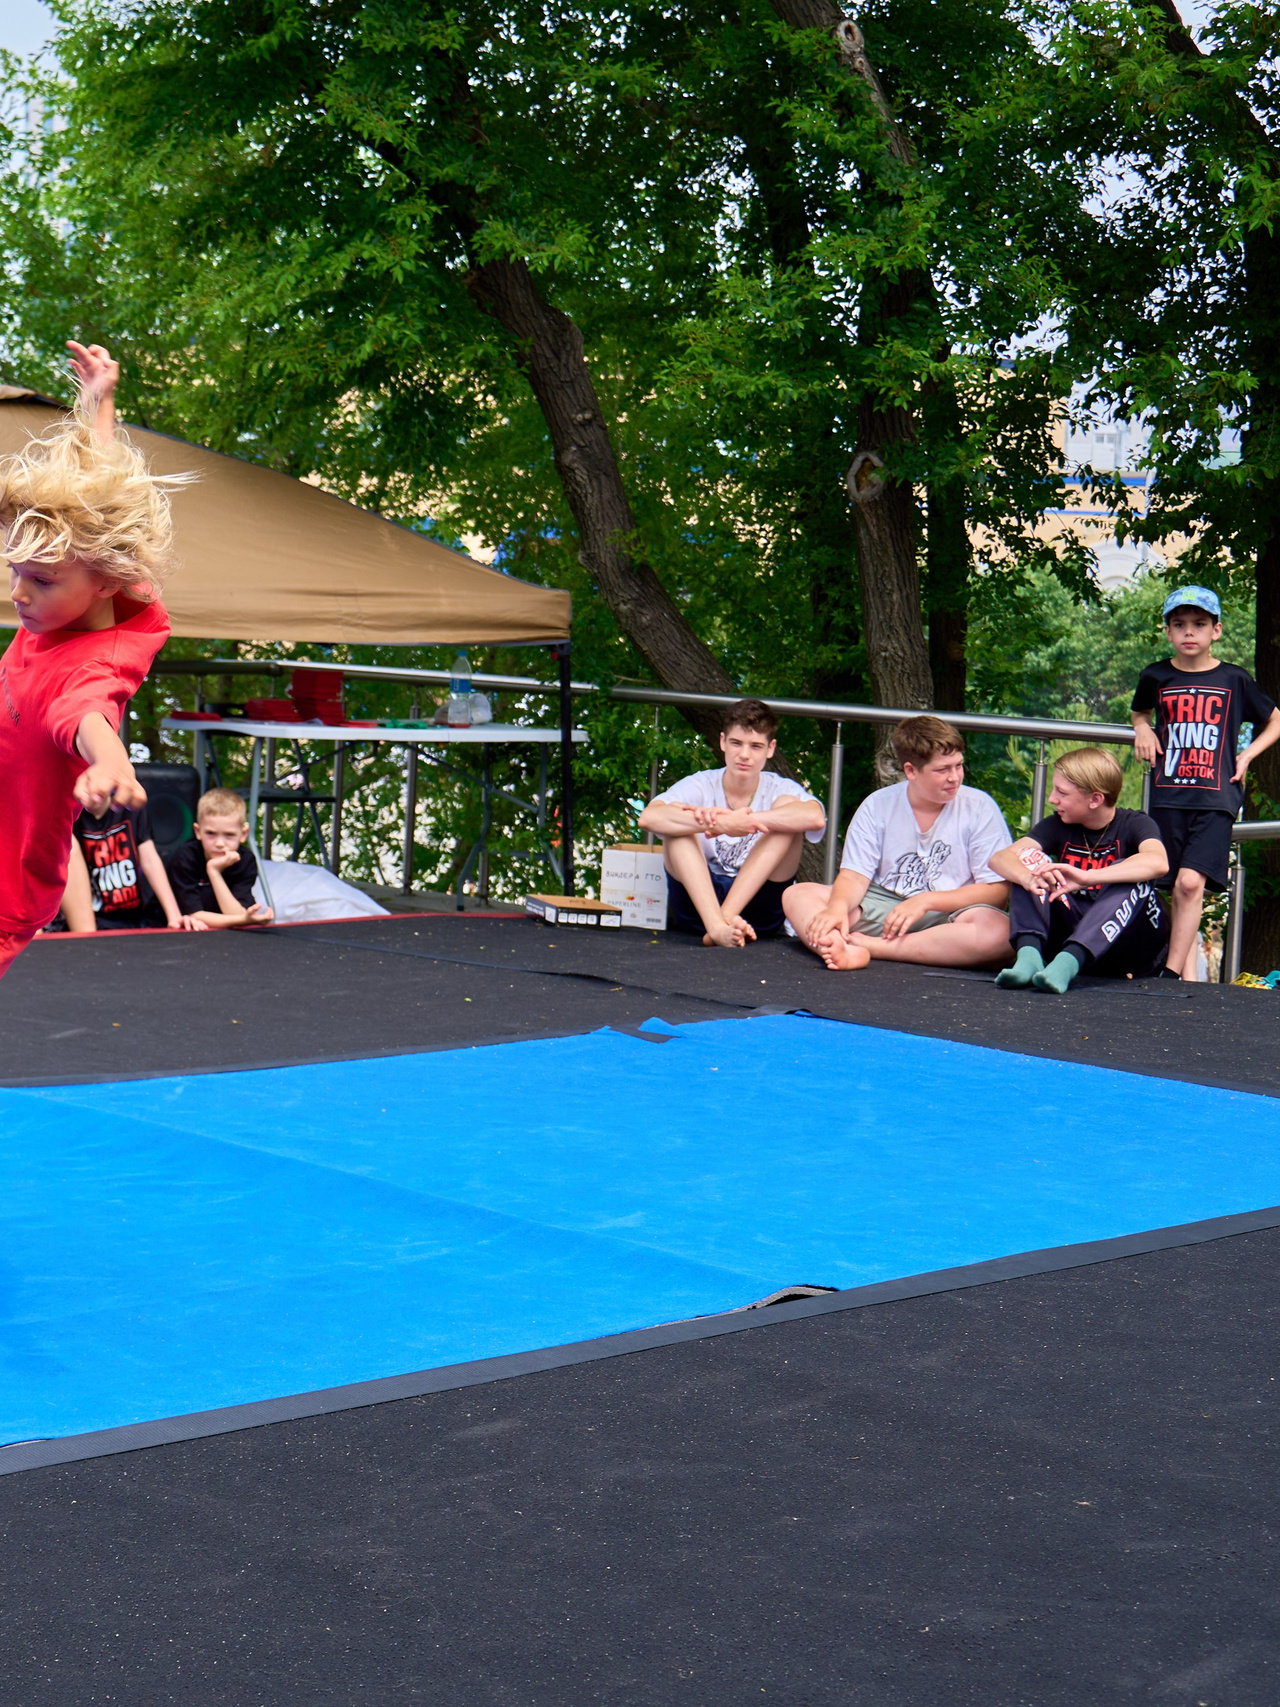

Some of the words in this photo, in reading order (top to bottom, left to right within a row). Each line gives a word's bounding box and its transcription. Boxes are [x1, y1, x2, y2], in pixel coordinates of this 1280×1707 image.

[1163, 695, 1223, 724] TRIC
[1167, 722, 1219, 751] KING
[1177, 765, 1215, 780] OSTOK
[644, 873, 662, 882] ГТО
